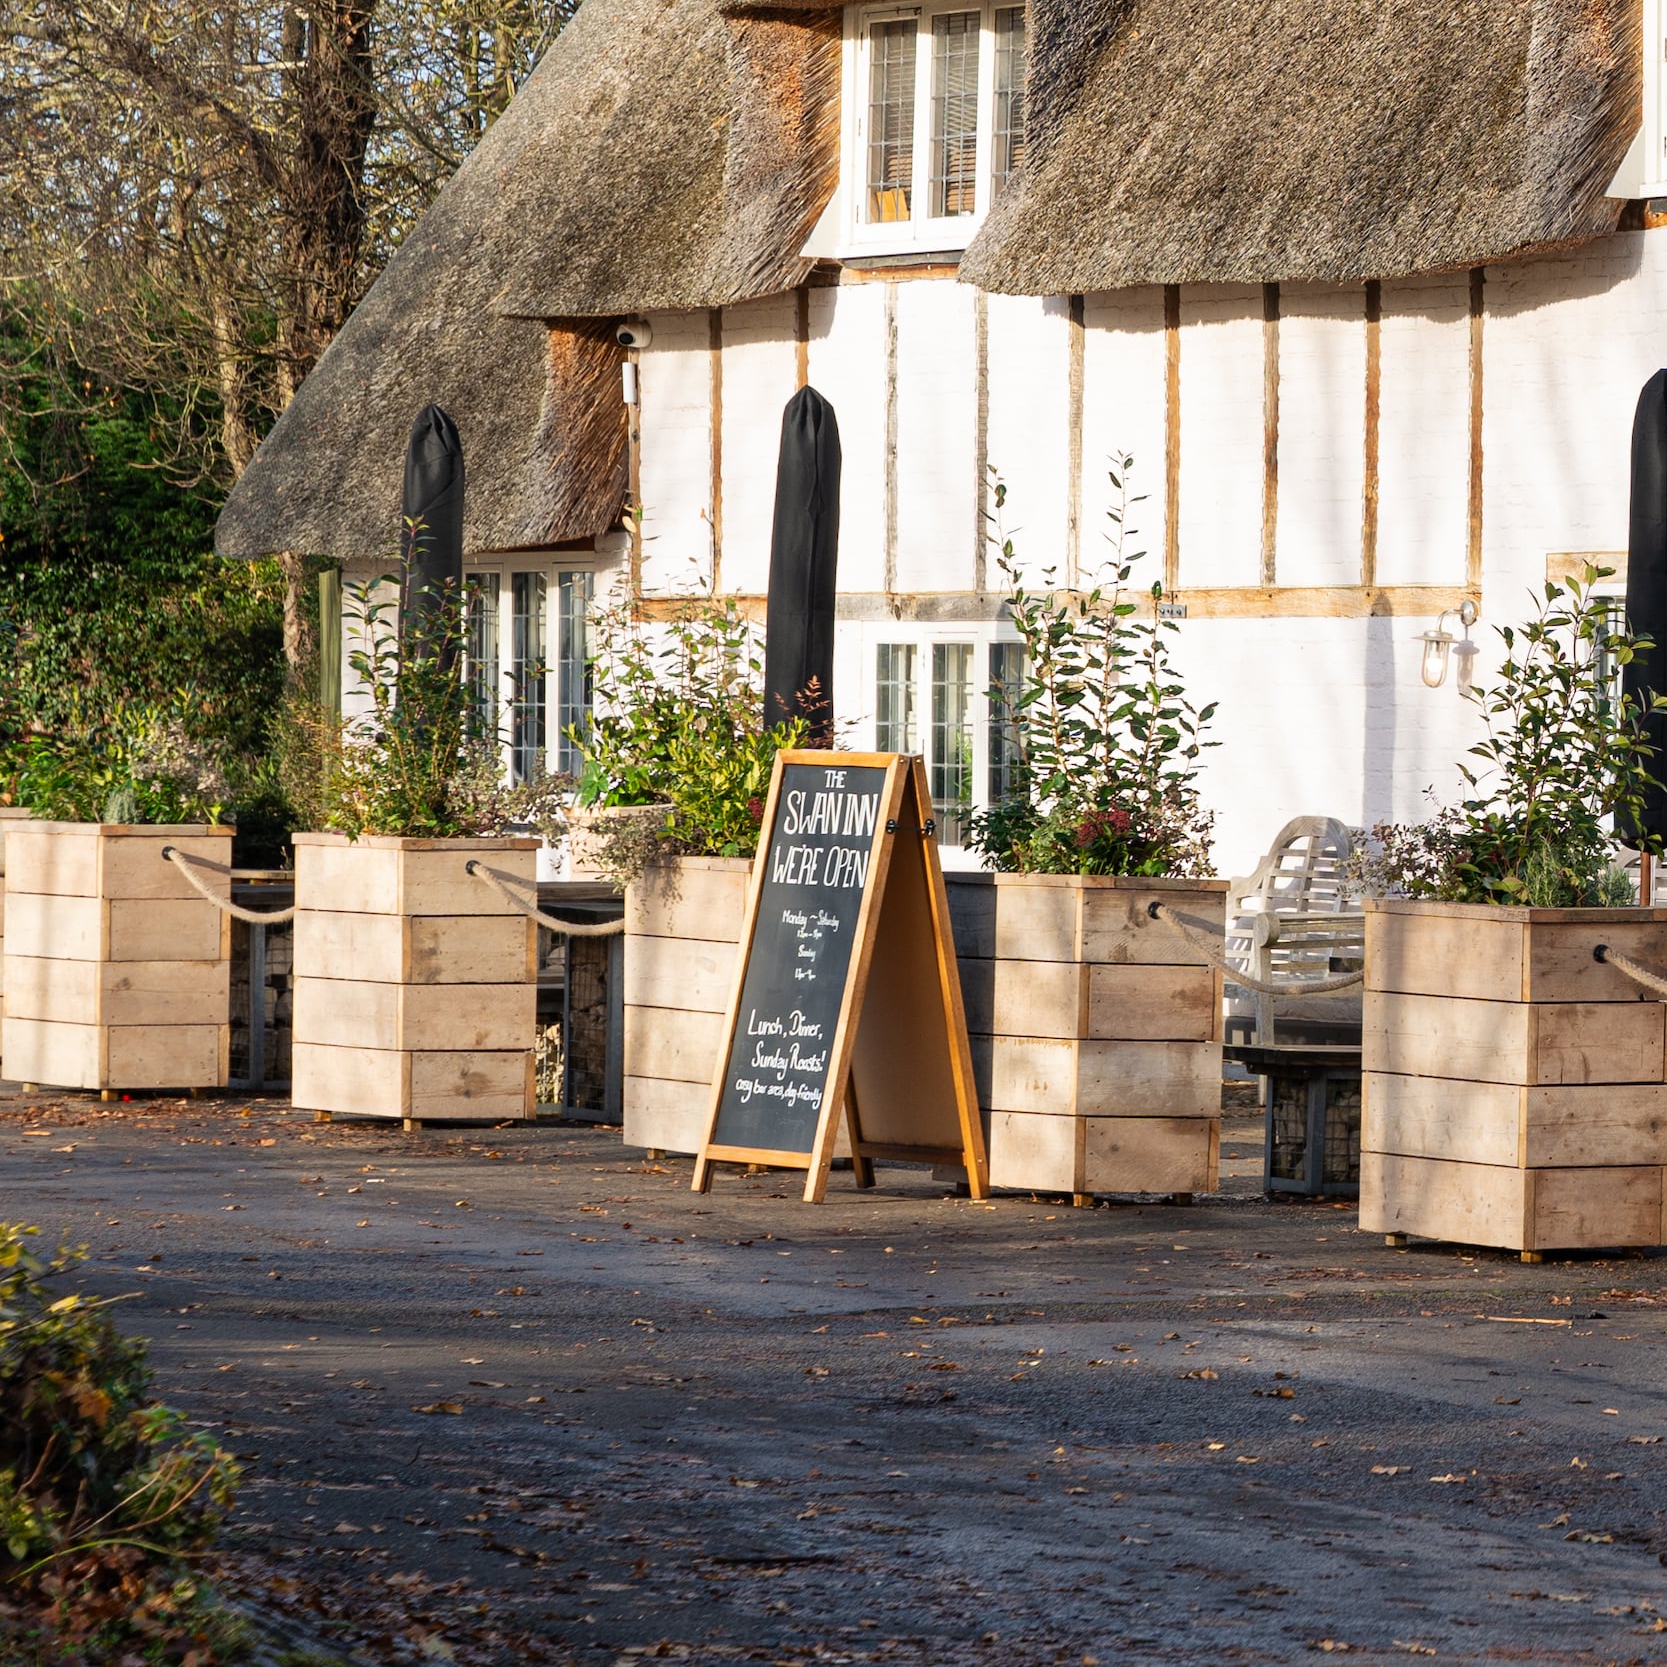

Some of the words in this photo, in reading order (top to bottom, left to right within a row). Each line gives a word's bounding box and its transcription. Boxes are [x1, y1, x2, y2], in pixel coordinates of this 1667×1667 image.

[824, 769, 847, 789] THE
[783, 789, 843, 835] SWAN
[841, 792, 879, 837] INN
[772, 844, 824, 885] WE'RE
[823, 845, 869, 888] OPEN
[782, 909, 807, 930] Monday
[817, 909, 840, 933] Saturday
[797, 943, 817, 963] Sunday
[747, 1008, 787, 1039] Lunch,
[789, 1009, 823, 1041] Dinner,
[751, 1040, 788, 1081] Sunday
[789, 1042, 827, 1073] Roasts!
[753, 1078, 767, 1095] bar
